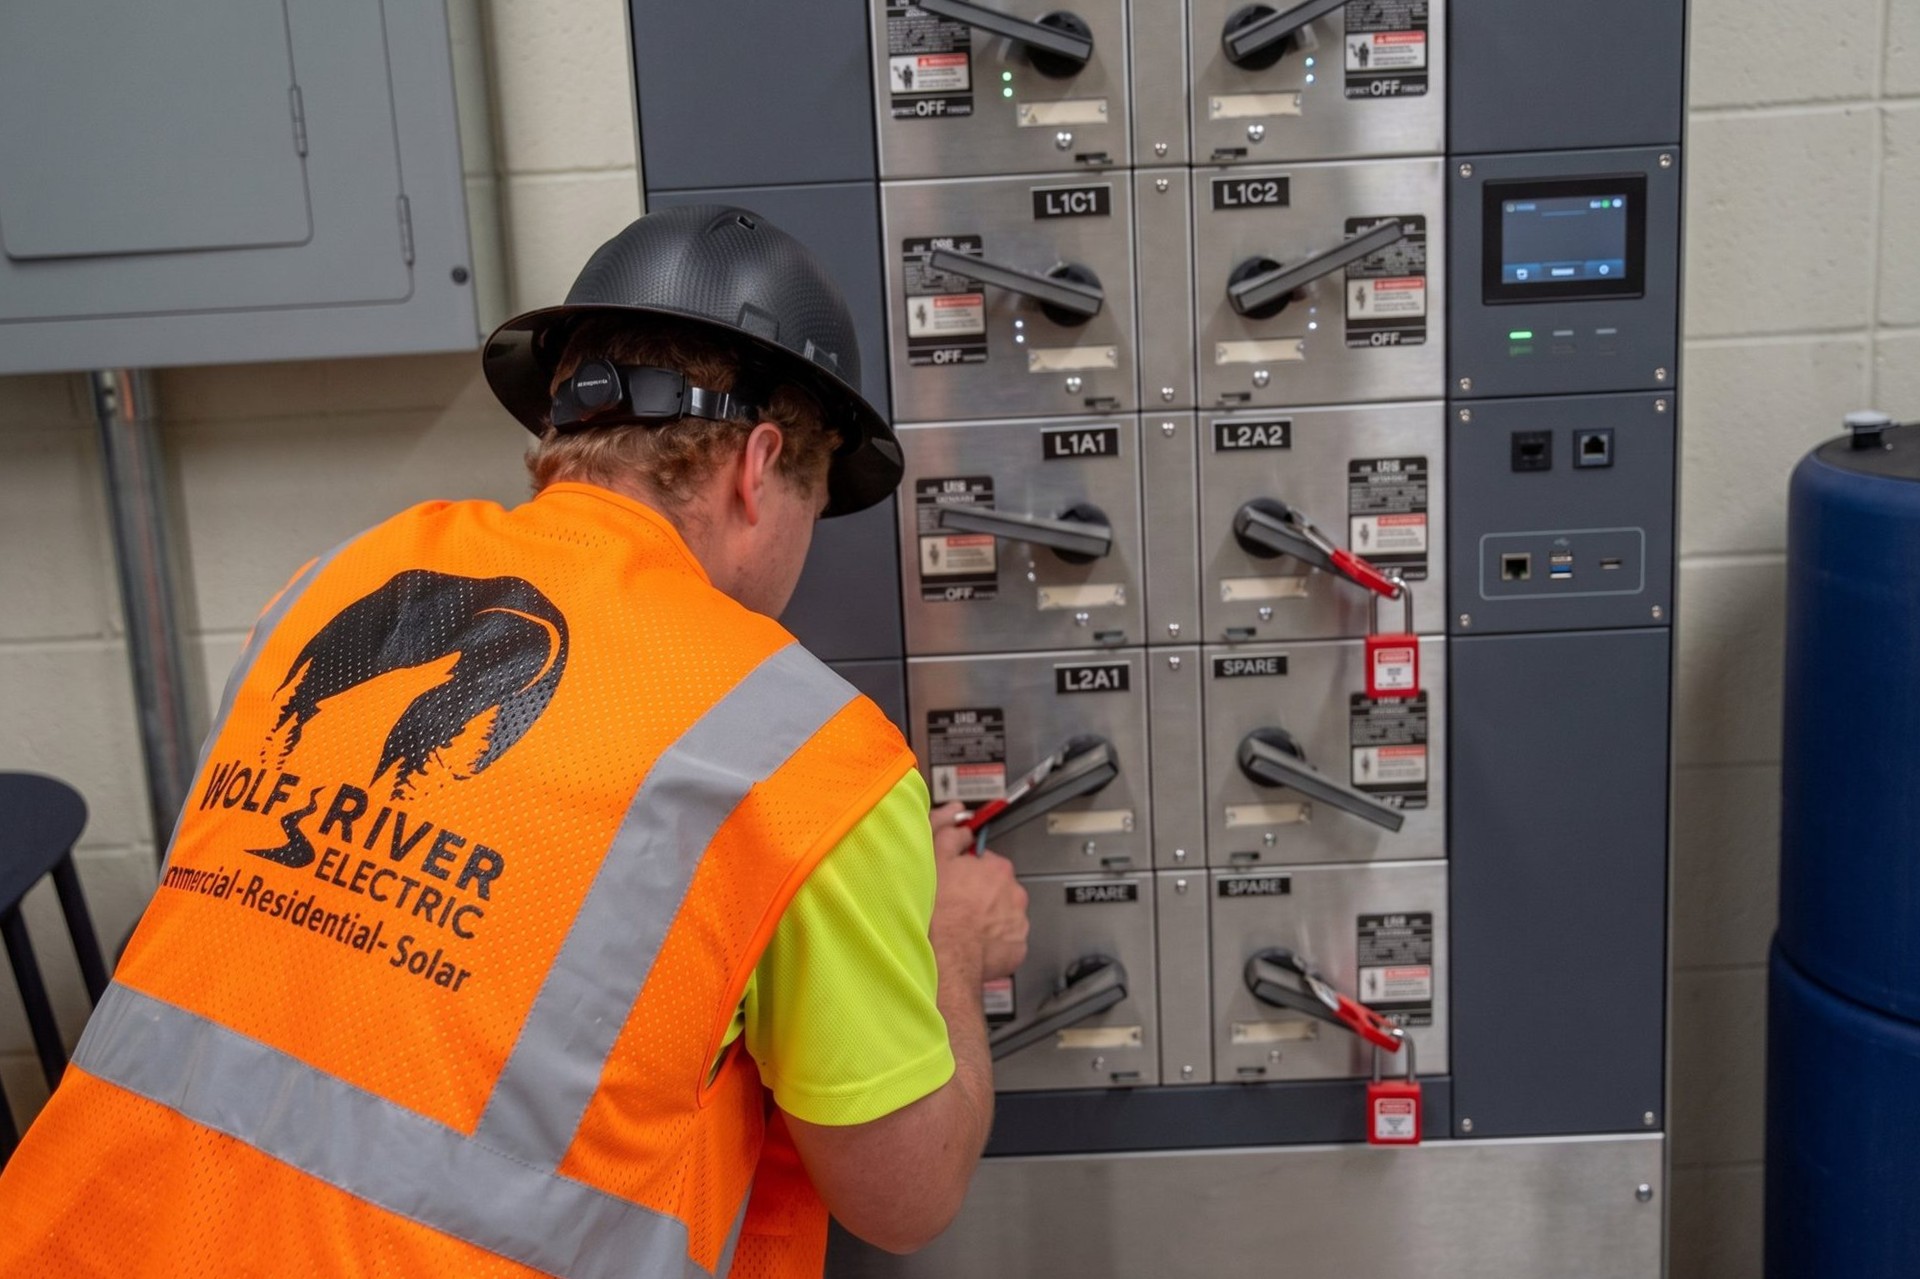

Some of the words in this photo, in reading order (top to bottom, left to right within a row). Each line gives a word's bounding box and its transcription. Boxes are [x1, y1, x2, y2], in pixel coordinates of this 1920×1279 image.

[1371, 80, 1400, 95] OFF
[916, 101, 946, 116] OFF
[1223, 182, 1279, 204] L1C2
[1046, 193, 1097, 215] L1C1
[1371, 332, 1400, 346] OFF
[933, 350, 962, 364] OFF
[1055, 432, 1107, 455] L1A1
[1222, 424, 1283, 447] L2A2
[945, 587, 974, 601] OFF
[1223, 658, 1278, 676] SPARE
[1064, 669, 1121, 690] L2A1
[201, 759, 301, 815] WOLF
[318, 783, 505, 902] RIVER
[314, 847, 485, 940] ELECTRIC
[1075, 884, 1129, 901] SPARE
[1227, 878, 1282, 895] SPARE
